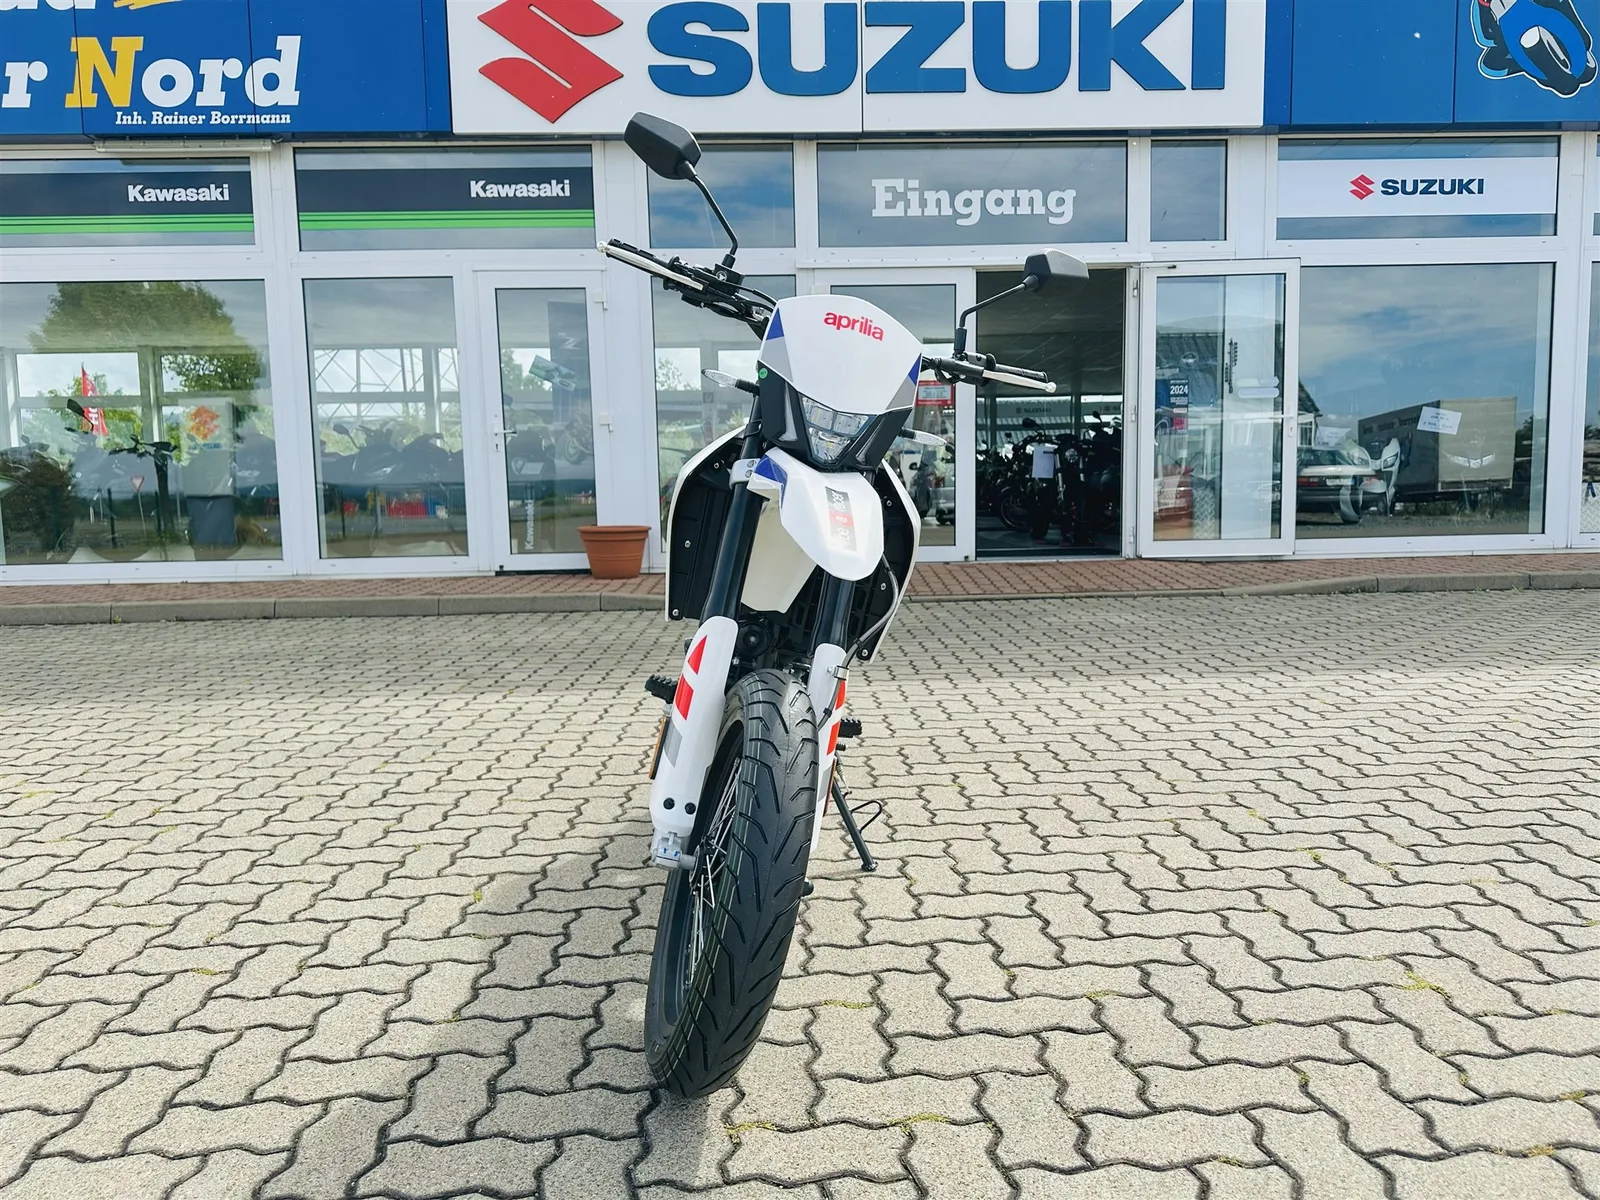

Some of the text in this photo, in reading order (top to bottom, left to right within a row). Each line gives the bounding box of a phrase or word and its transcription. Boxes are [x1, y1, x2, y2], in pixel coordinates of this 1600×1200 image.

[648, 0, 1225, 97] SUZUKI
[65, 35, 301, 108] Nord
[115, 111, 291, 125] Inh. Rainer Borrmann
[127, 184, 230, 202] Kawasaki
[470, 179, 570, 198] Kawasaki
[1380, 178, 1484, 196] SUZUKI
[871, 178, 1077, 226] Eingang
[823, 312, 884, 341] aprilia
[1170, 385, 1188, 395] 2024
[524, 499, 534, 550] Kawasaki
